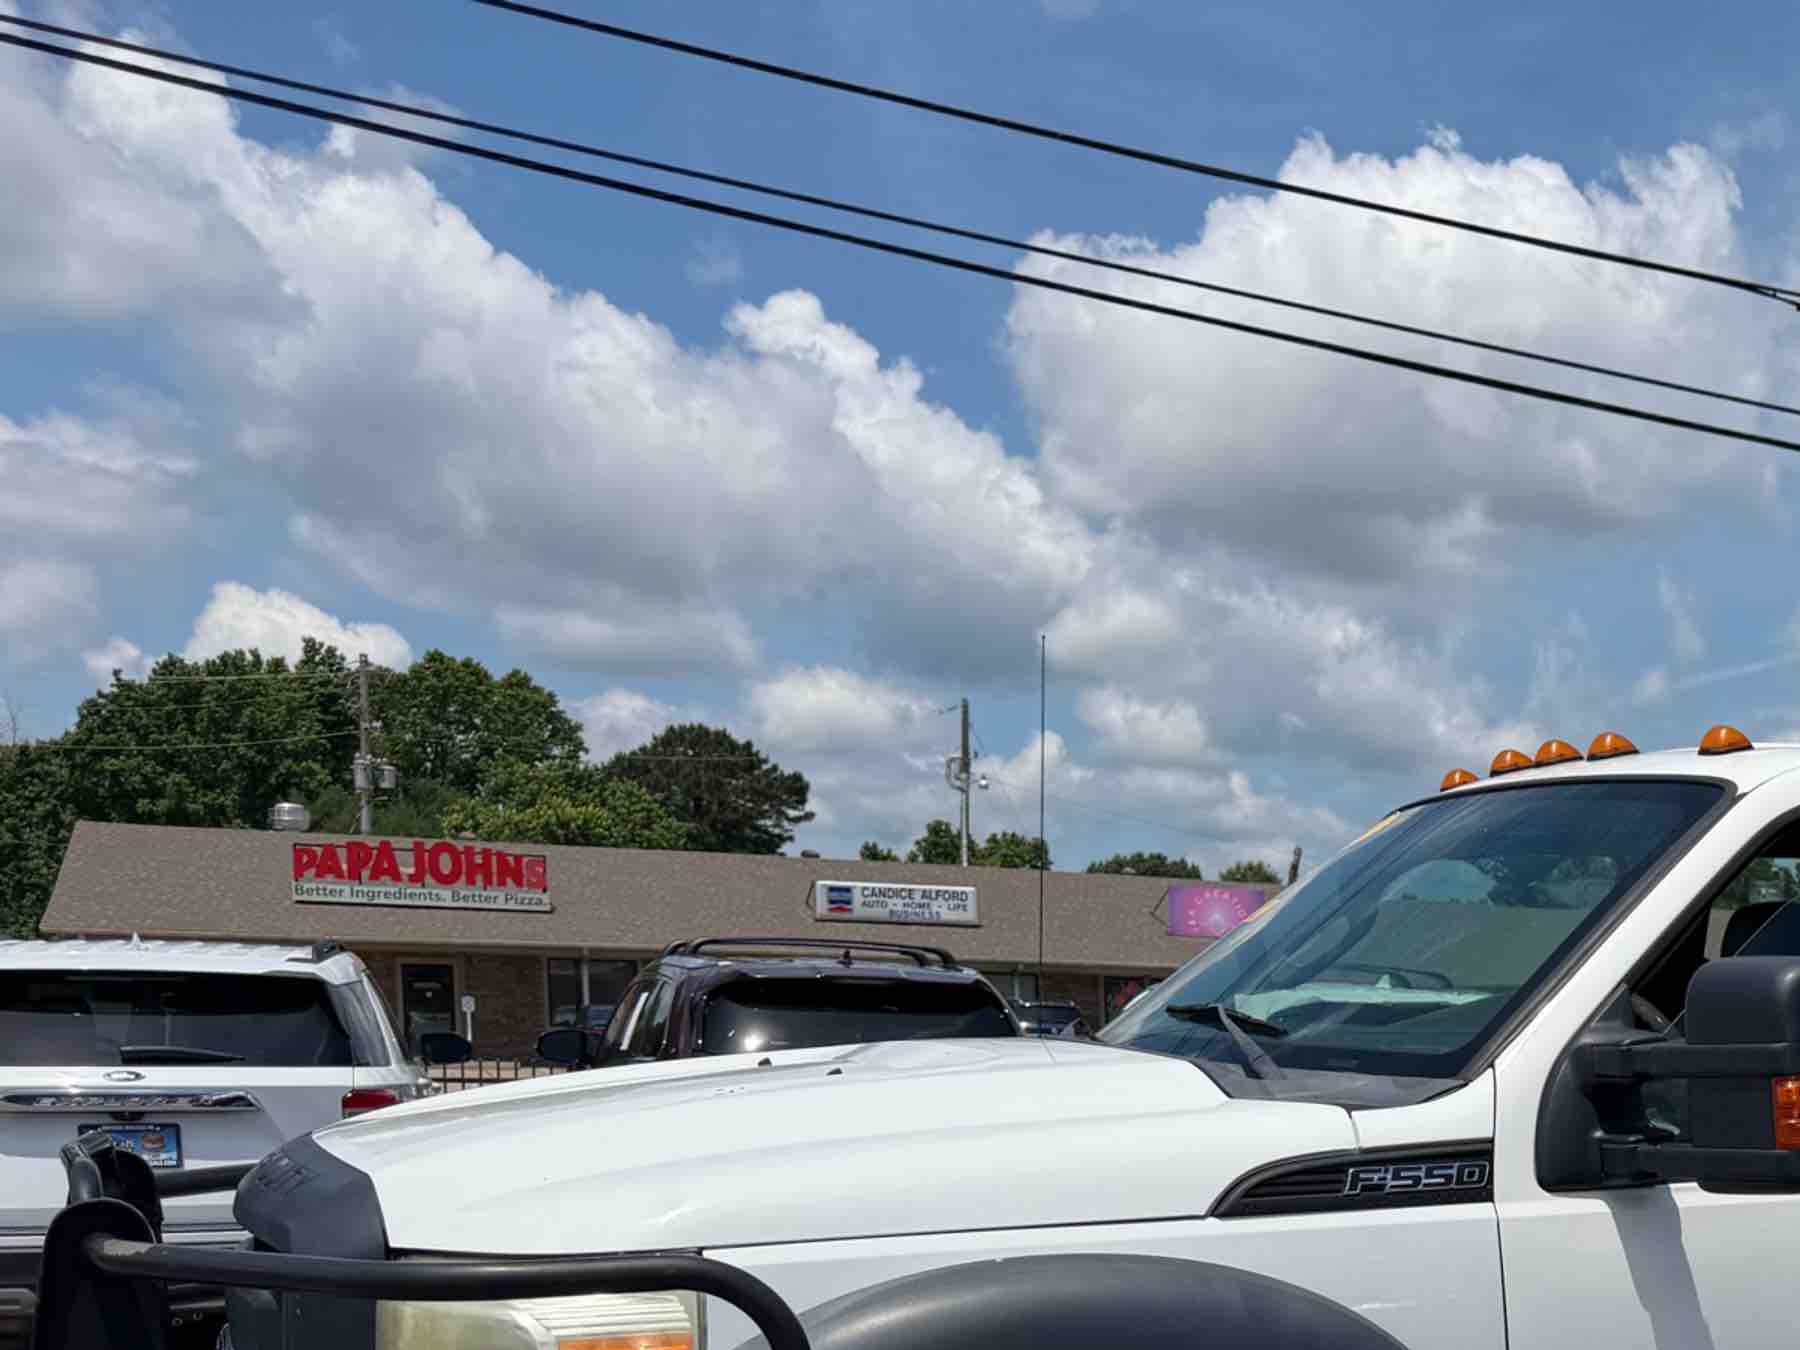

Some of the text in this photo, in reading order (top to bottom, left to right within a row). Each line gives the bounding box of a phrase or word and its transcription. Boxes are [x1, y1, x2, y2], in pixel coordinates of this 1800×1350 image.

[293, 839, 545, 890] PAPA JOHNS
[295, 884, 345, 897] Better
[350, 886, 447, 902] Ingredients.
[451, 890, 499, 905] Better
[861, 886, 969, 902] CANDICE ALFORD
[861, 900, 968, 912] AUTO HOME LIFE
[889, 909, 942, 921] BUSINESS
[1342, 1161, 1490, 1196] F-550
